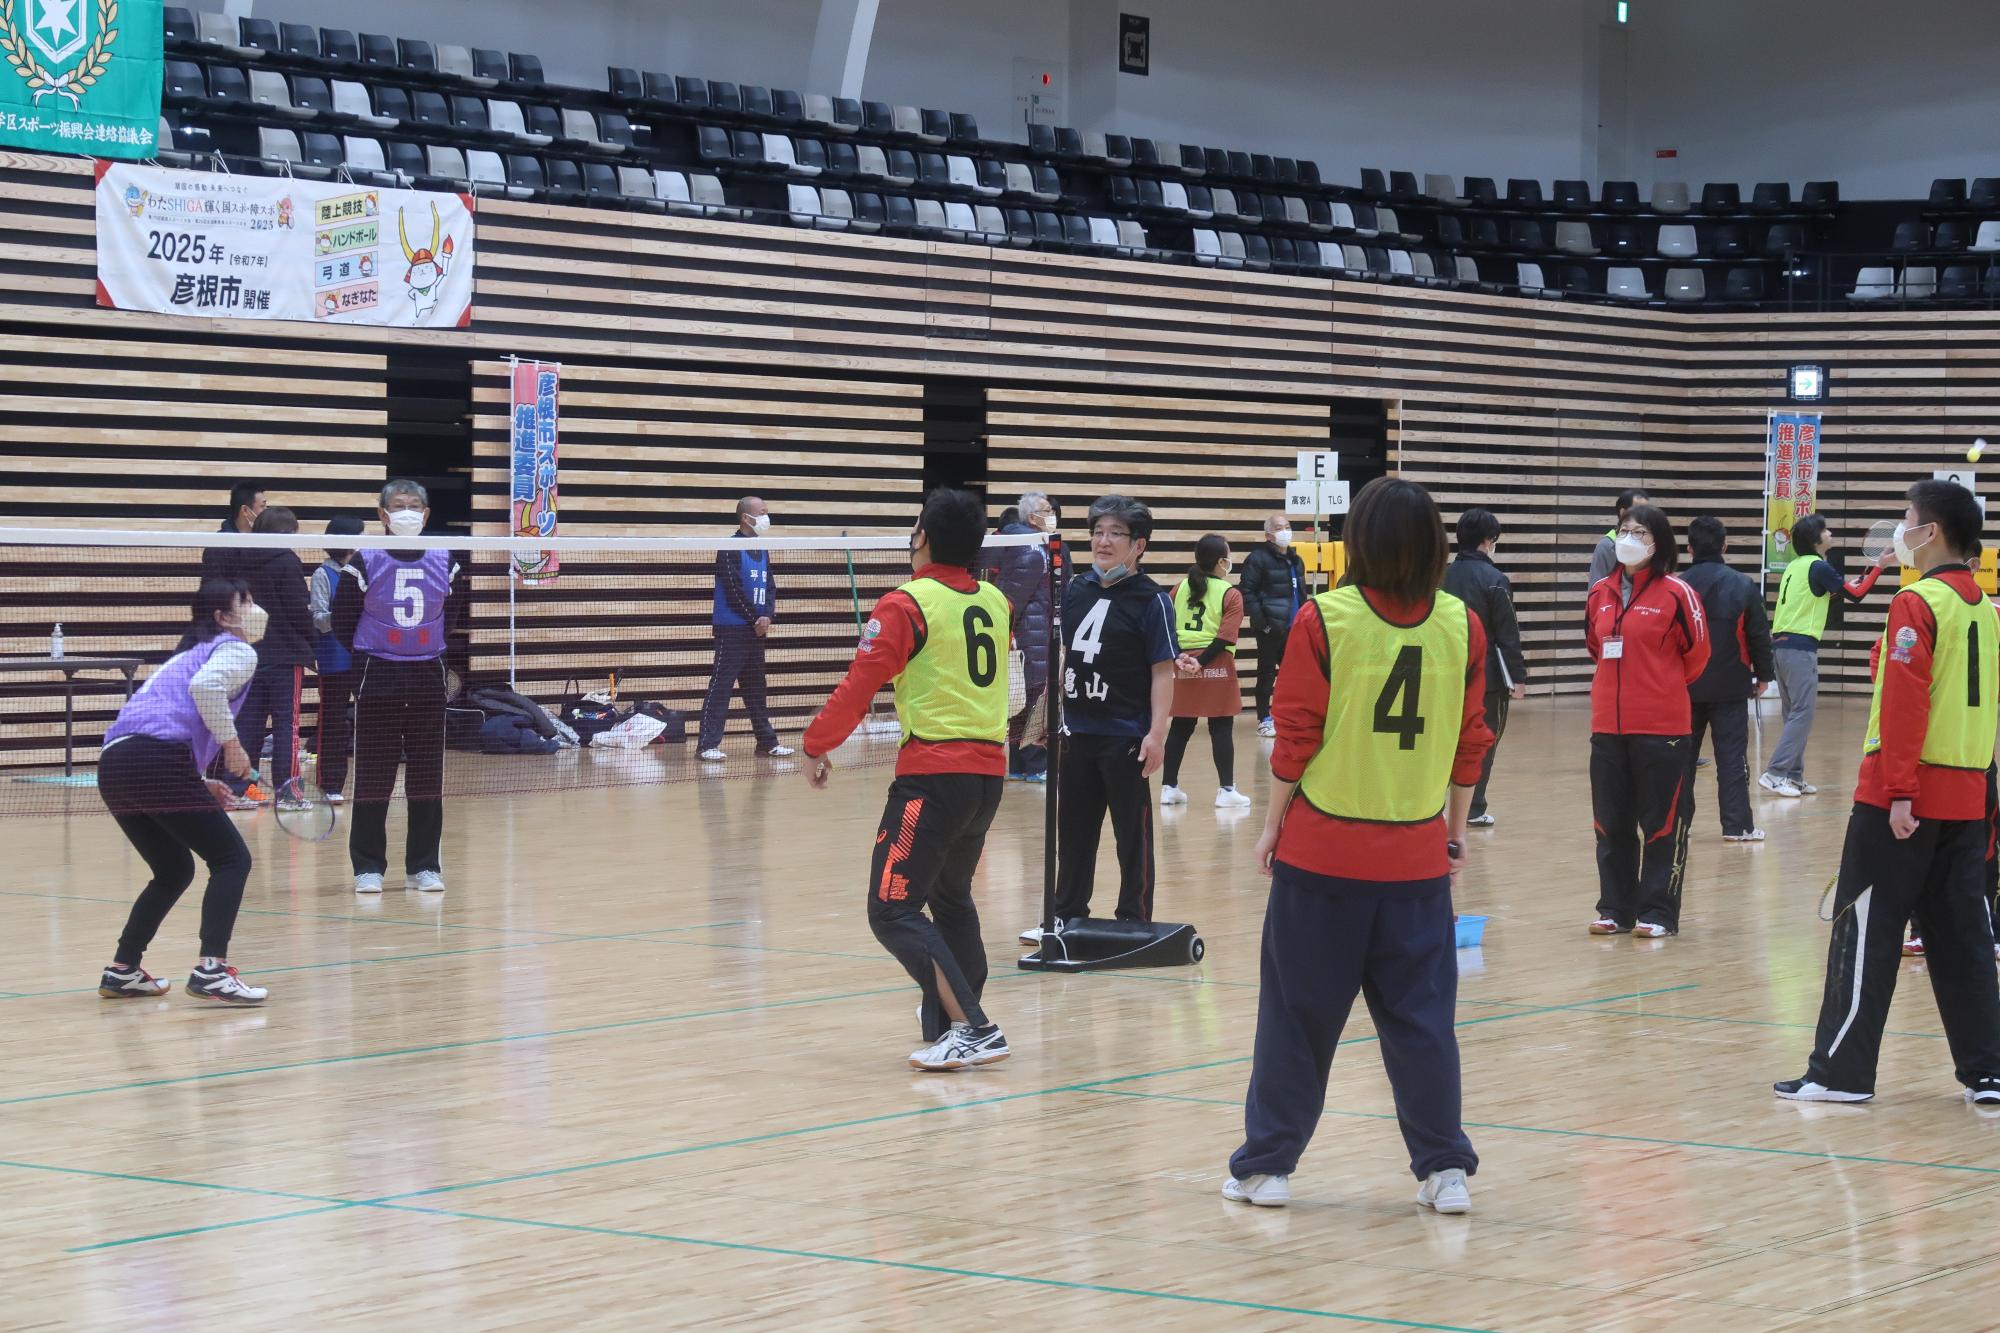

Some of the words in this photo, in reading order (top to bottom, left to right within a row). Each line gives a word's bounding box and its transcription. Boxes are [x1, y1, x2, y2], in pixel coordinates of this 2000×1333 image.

[321, 199, 363, 220] 陸上競技
[332, 228, 377, 248] ハンドボール
[341, 288, 377, 307] なぎなた
[513, 402, 537, 503] 推進委員
[536, 370, 557, 537] 彦根市スポーツ
[1314, 455, 1325, 478] E
[1775, 423, 1796, 499] 推進委員
[1794, 422, 1817, 518] 彦根市スポ
[1328, 495, 1343, 505] TLG
[393, 568, 424, 627] 5
[753, 587, 765, 605] 10
[1184, 600, 1207, 632] 3
[962, 605, 997, 687] 6
[1071, 598, 1112, 664] 4
[1967, 620, 1980, 707] 1
[1373, 645, 1425, 750] 4
